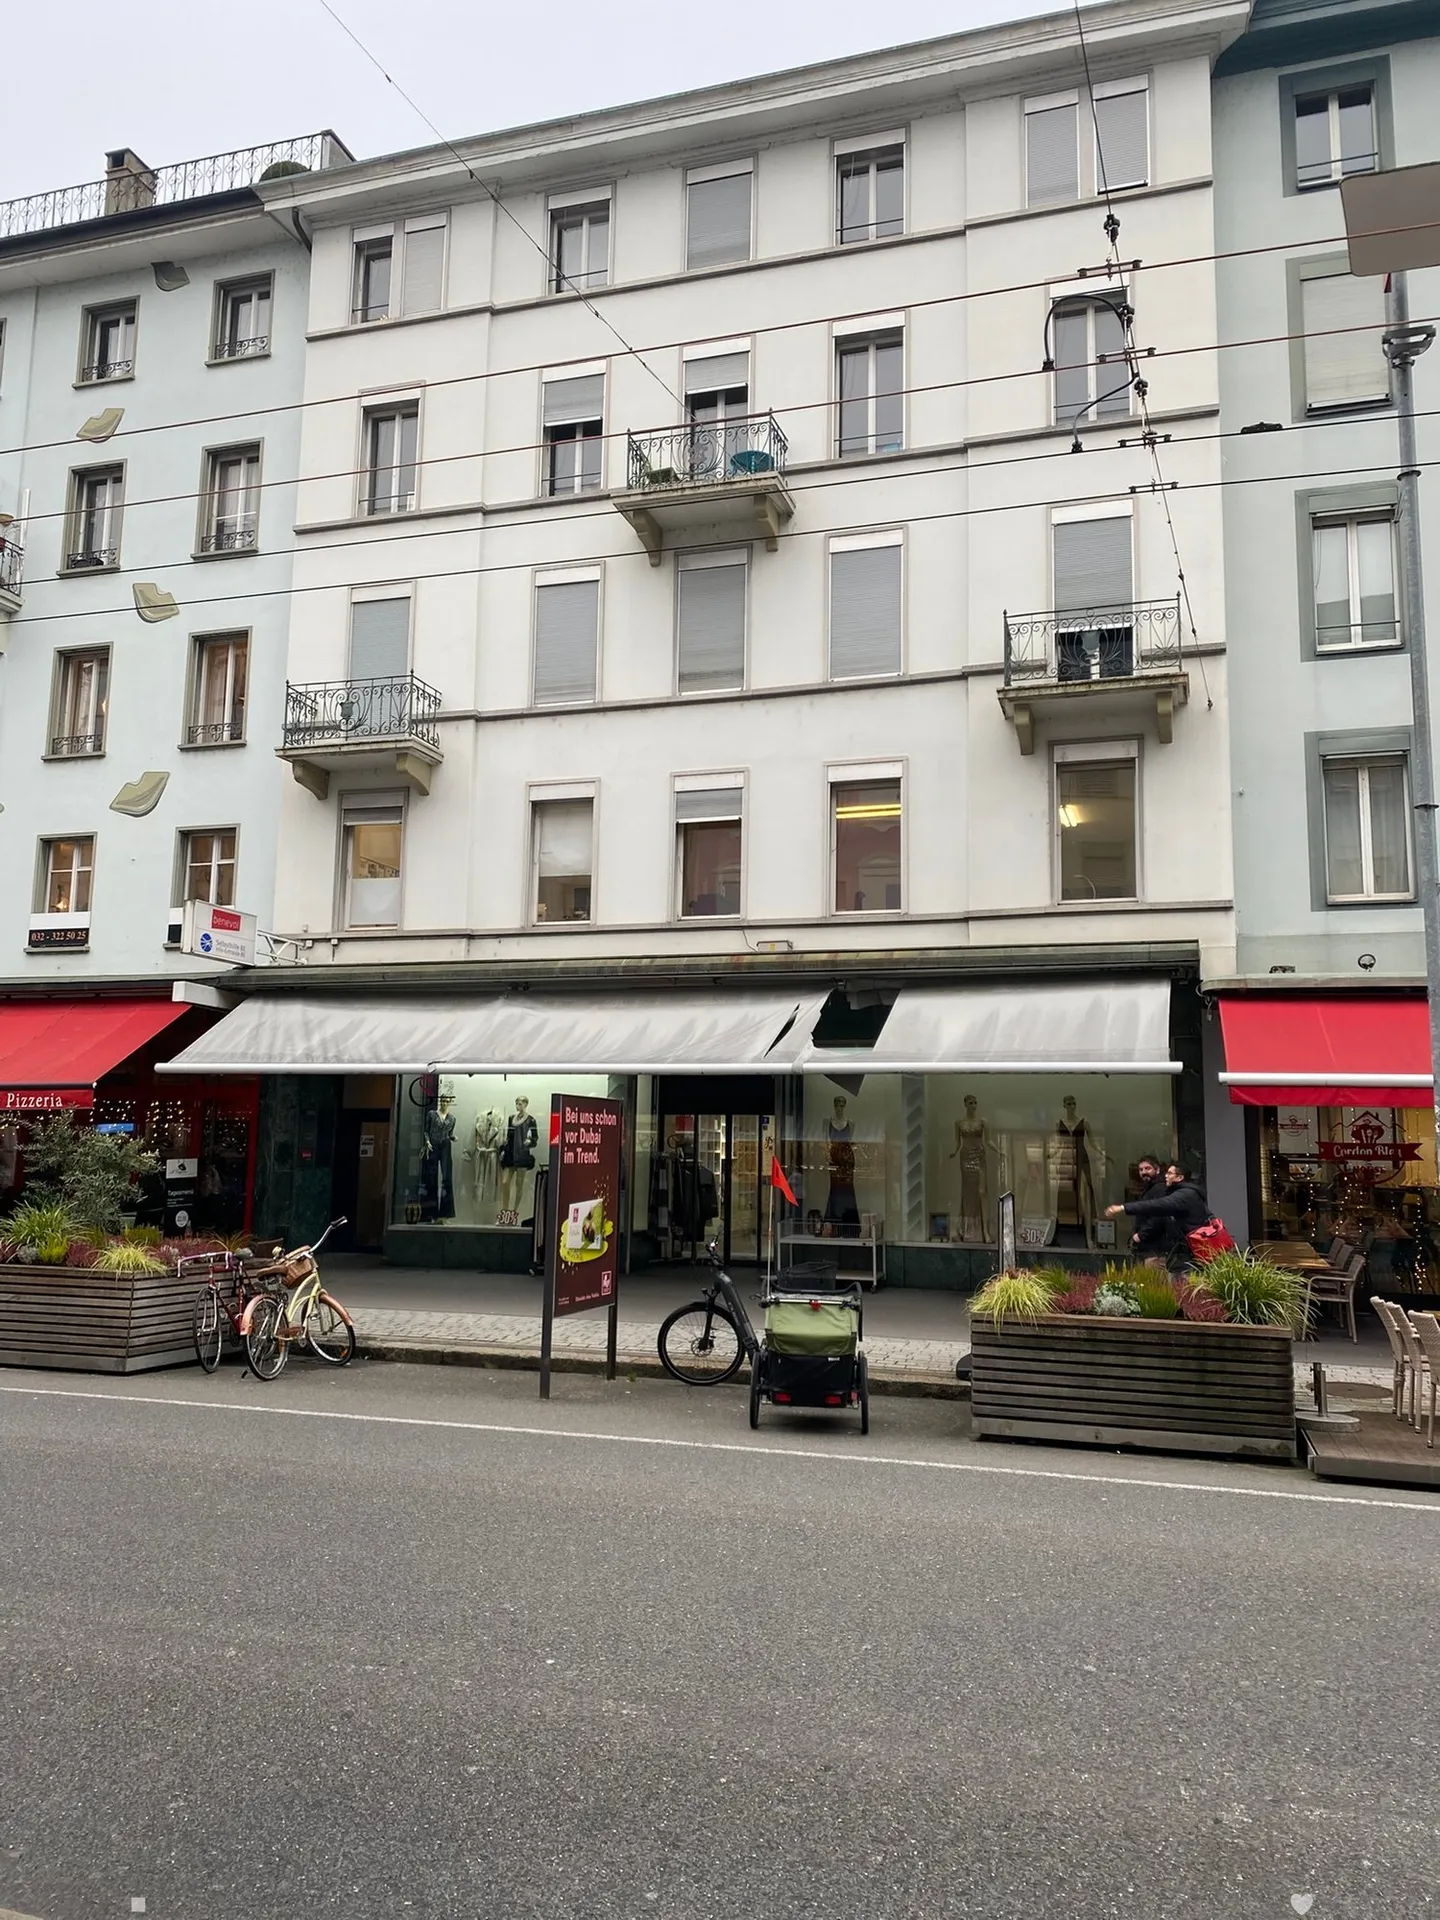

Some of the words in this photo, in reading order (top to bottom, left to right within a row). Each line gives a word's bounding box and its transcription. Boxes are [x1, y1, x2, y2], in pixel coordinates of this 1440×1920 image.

[213, 916, 239, 929] benevol
[31, 932, 45, 941] 032
[51, 932, 64, 940] 322
[66, 931, 76, 940] 50
[76, 931, 87, 940] 25
[6, 1092, 63, 1108] Pizzeria
[565, 1106, 578, 1123] Bei
[580, 1112, 594, 1125] uns
[595, 1108, 617, 1126] schon
[565, 1131, 578, 1144] vor
[580, 1127, 601, 1144] Dubai
[564, 1146, 575, 1164] im
[576, 1146, 600, 1164] Trend.
